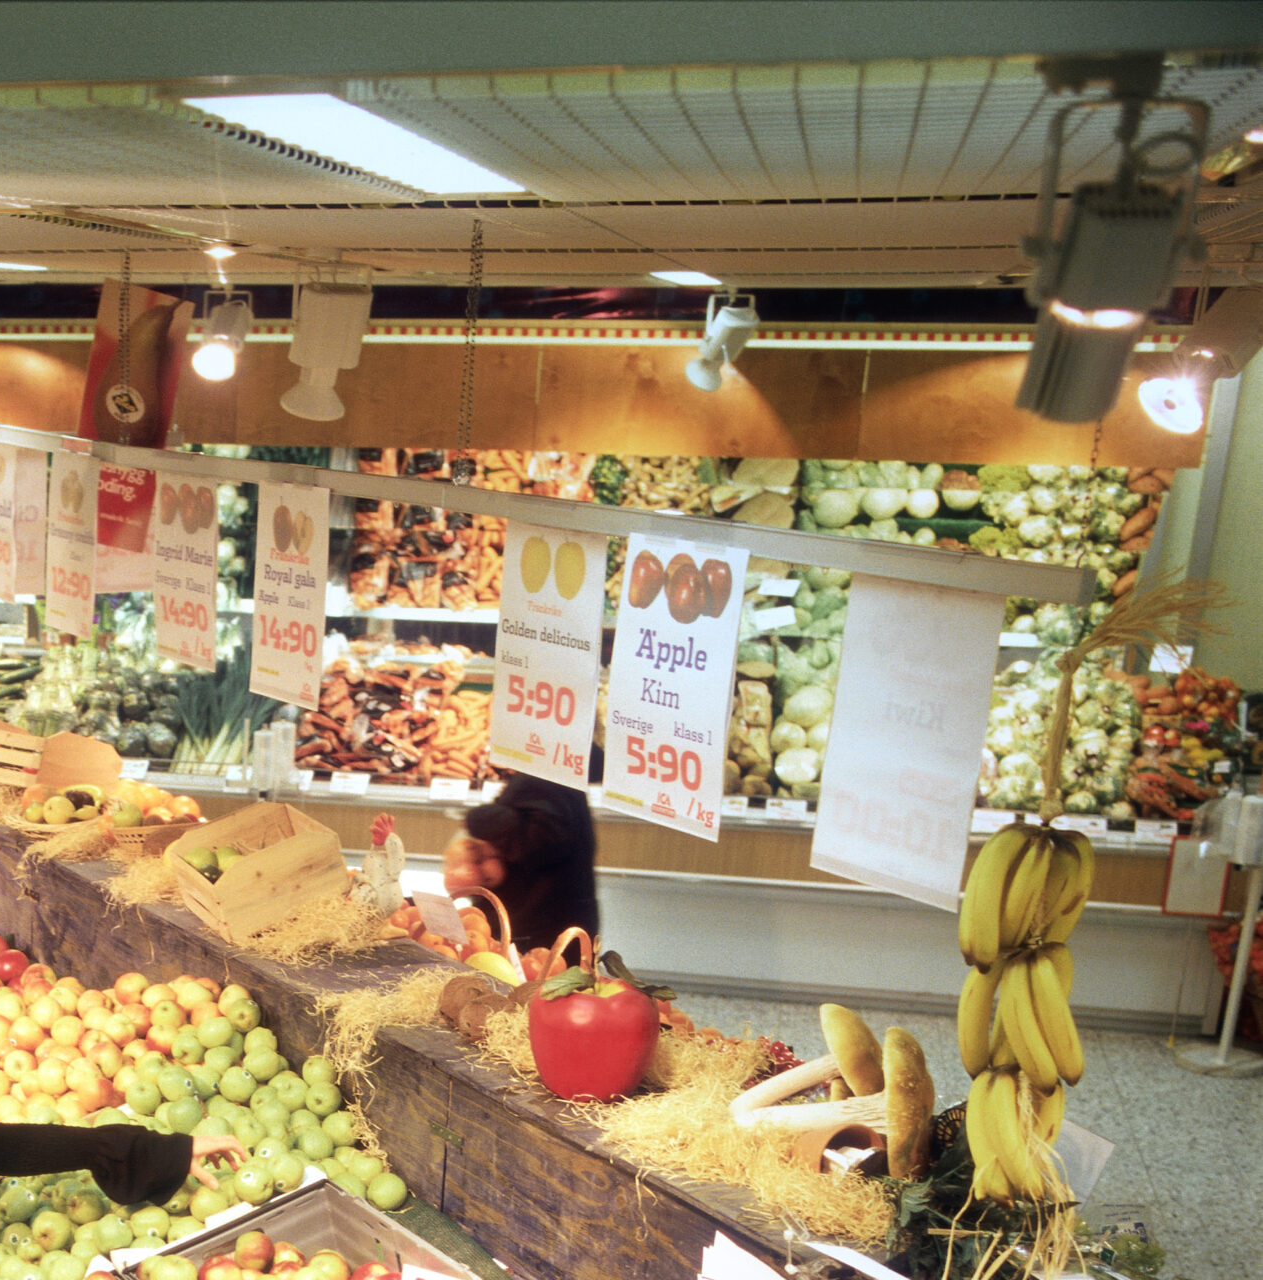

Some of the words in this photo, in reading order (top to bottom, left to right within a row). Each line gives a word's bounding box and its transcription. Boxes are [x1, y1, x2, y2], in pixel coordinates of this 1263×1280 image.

[51, 566, 91, 601] 12:90
[264, 563, 292, 586] Royal
[294, 570, 316, 589] gala
[160, 595, 209, 632] 14:90
[259, 614, 317, 658] 14:90
[501, 618, 538, 641] Golden
[539, 626, 591, 652] delicious
[635, 627, 707, 673] Äpple
[500, 650, 523, 668] klass
[506, 674, 576, 727] 5:90
[640, 677, 680, 710] Kim
[612, 710, 654, 736] Sverige
[673, 721, 704, 743] klass
[627, 735, 702, 792] 5:90
